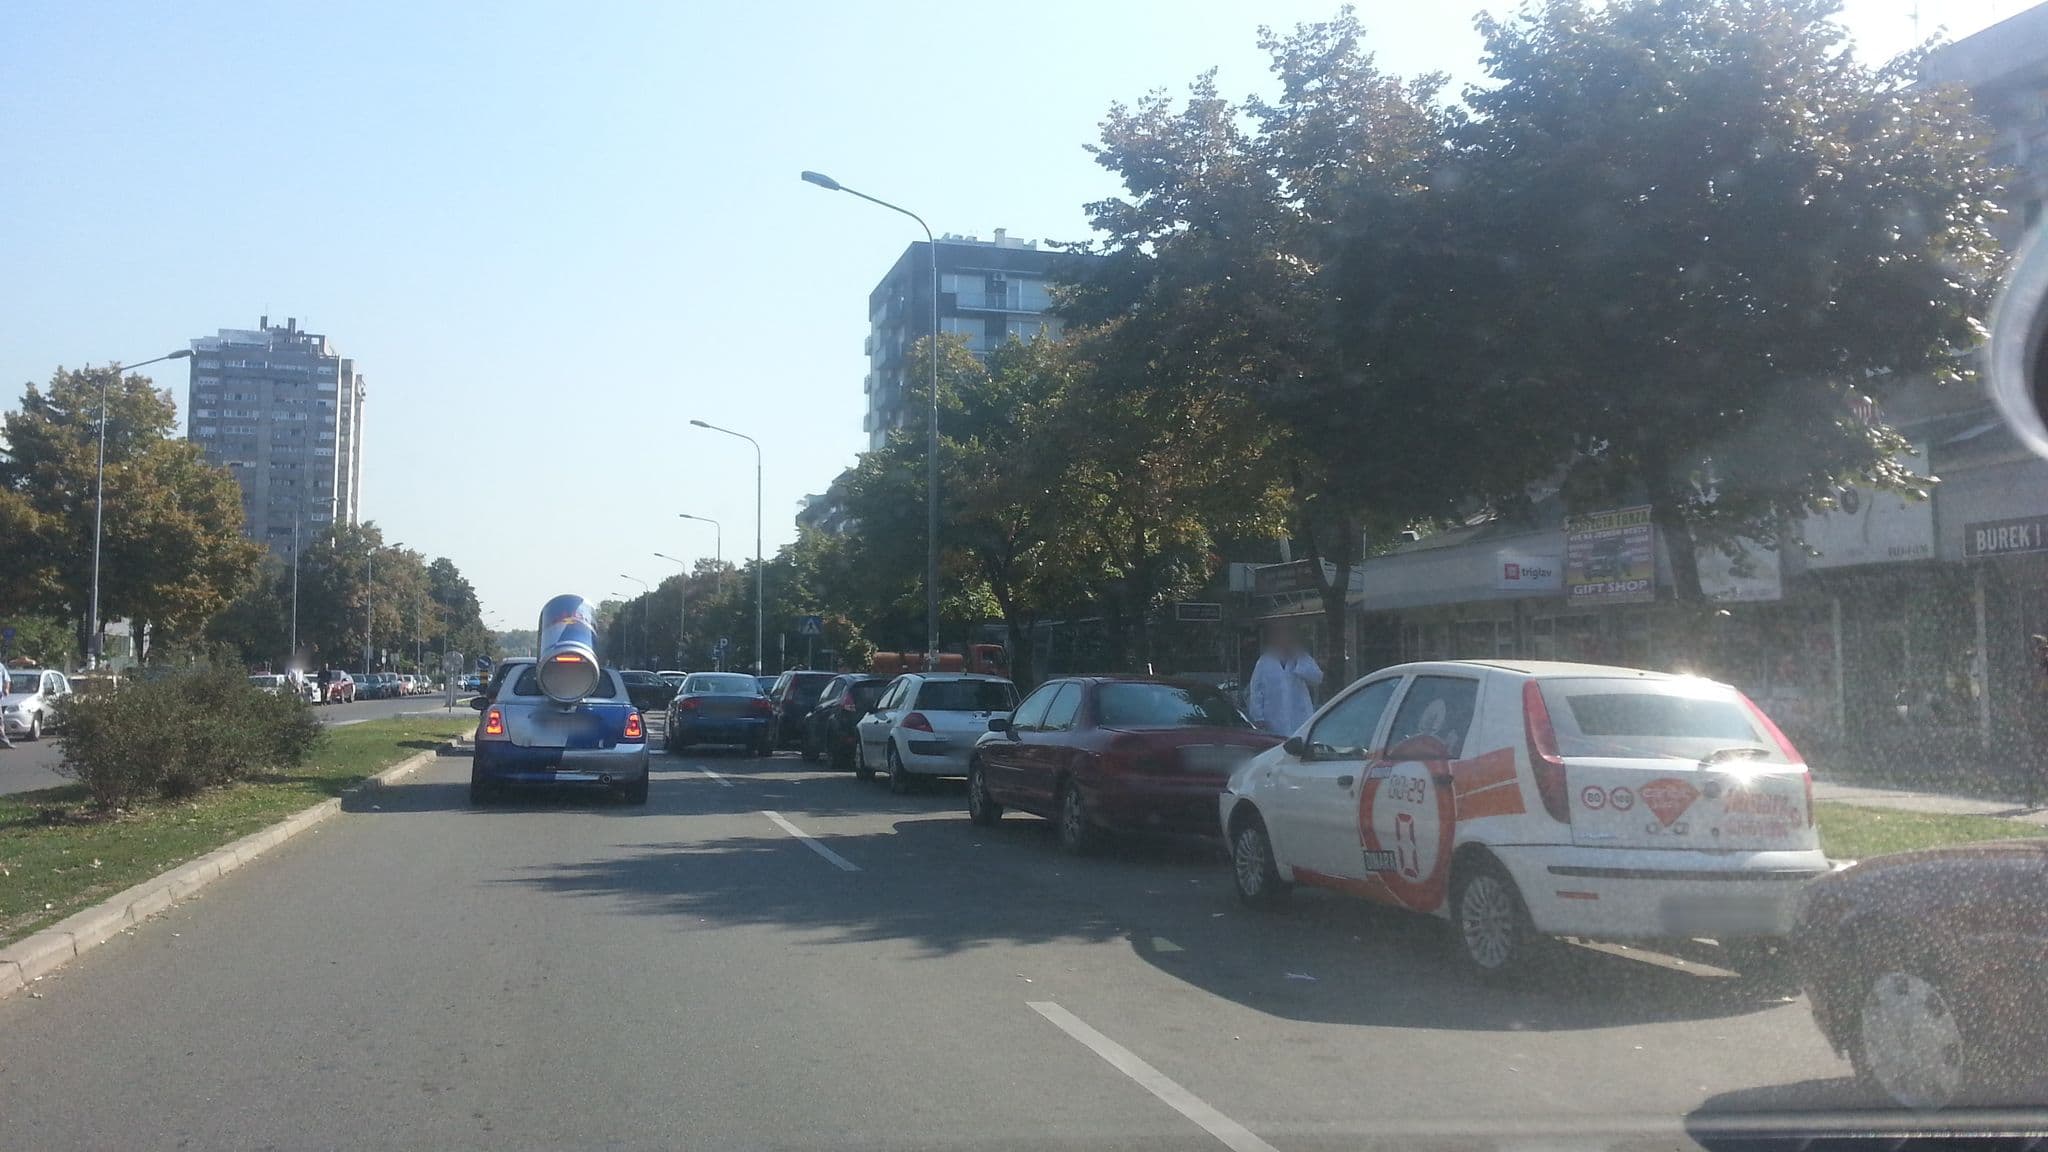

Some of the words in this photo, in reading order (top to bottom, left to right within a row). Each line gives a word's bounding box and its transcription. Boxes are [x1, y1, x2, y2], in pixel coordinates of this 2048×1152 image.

[1976, 524, 2030, 553] BUREK
[1521, 566, 1552, 580] triglav
[1574, 583, 1604, 595] GIFT
[1607, 580, 1648, 592] SHOP
[1586, 792, 1601, 803] 80
